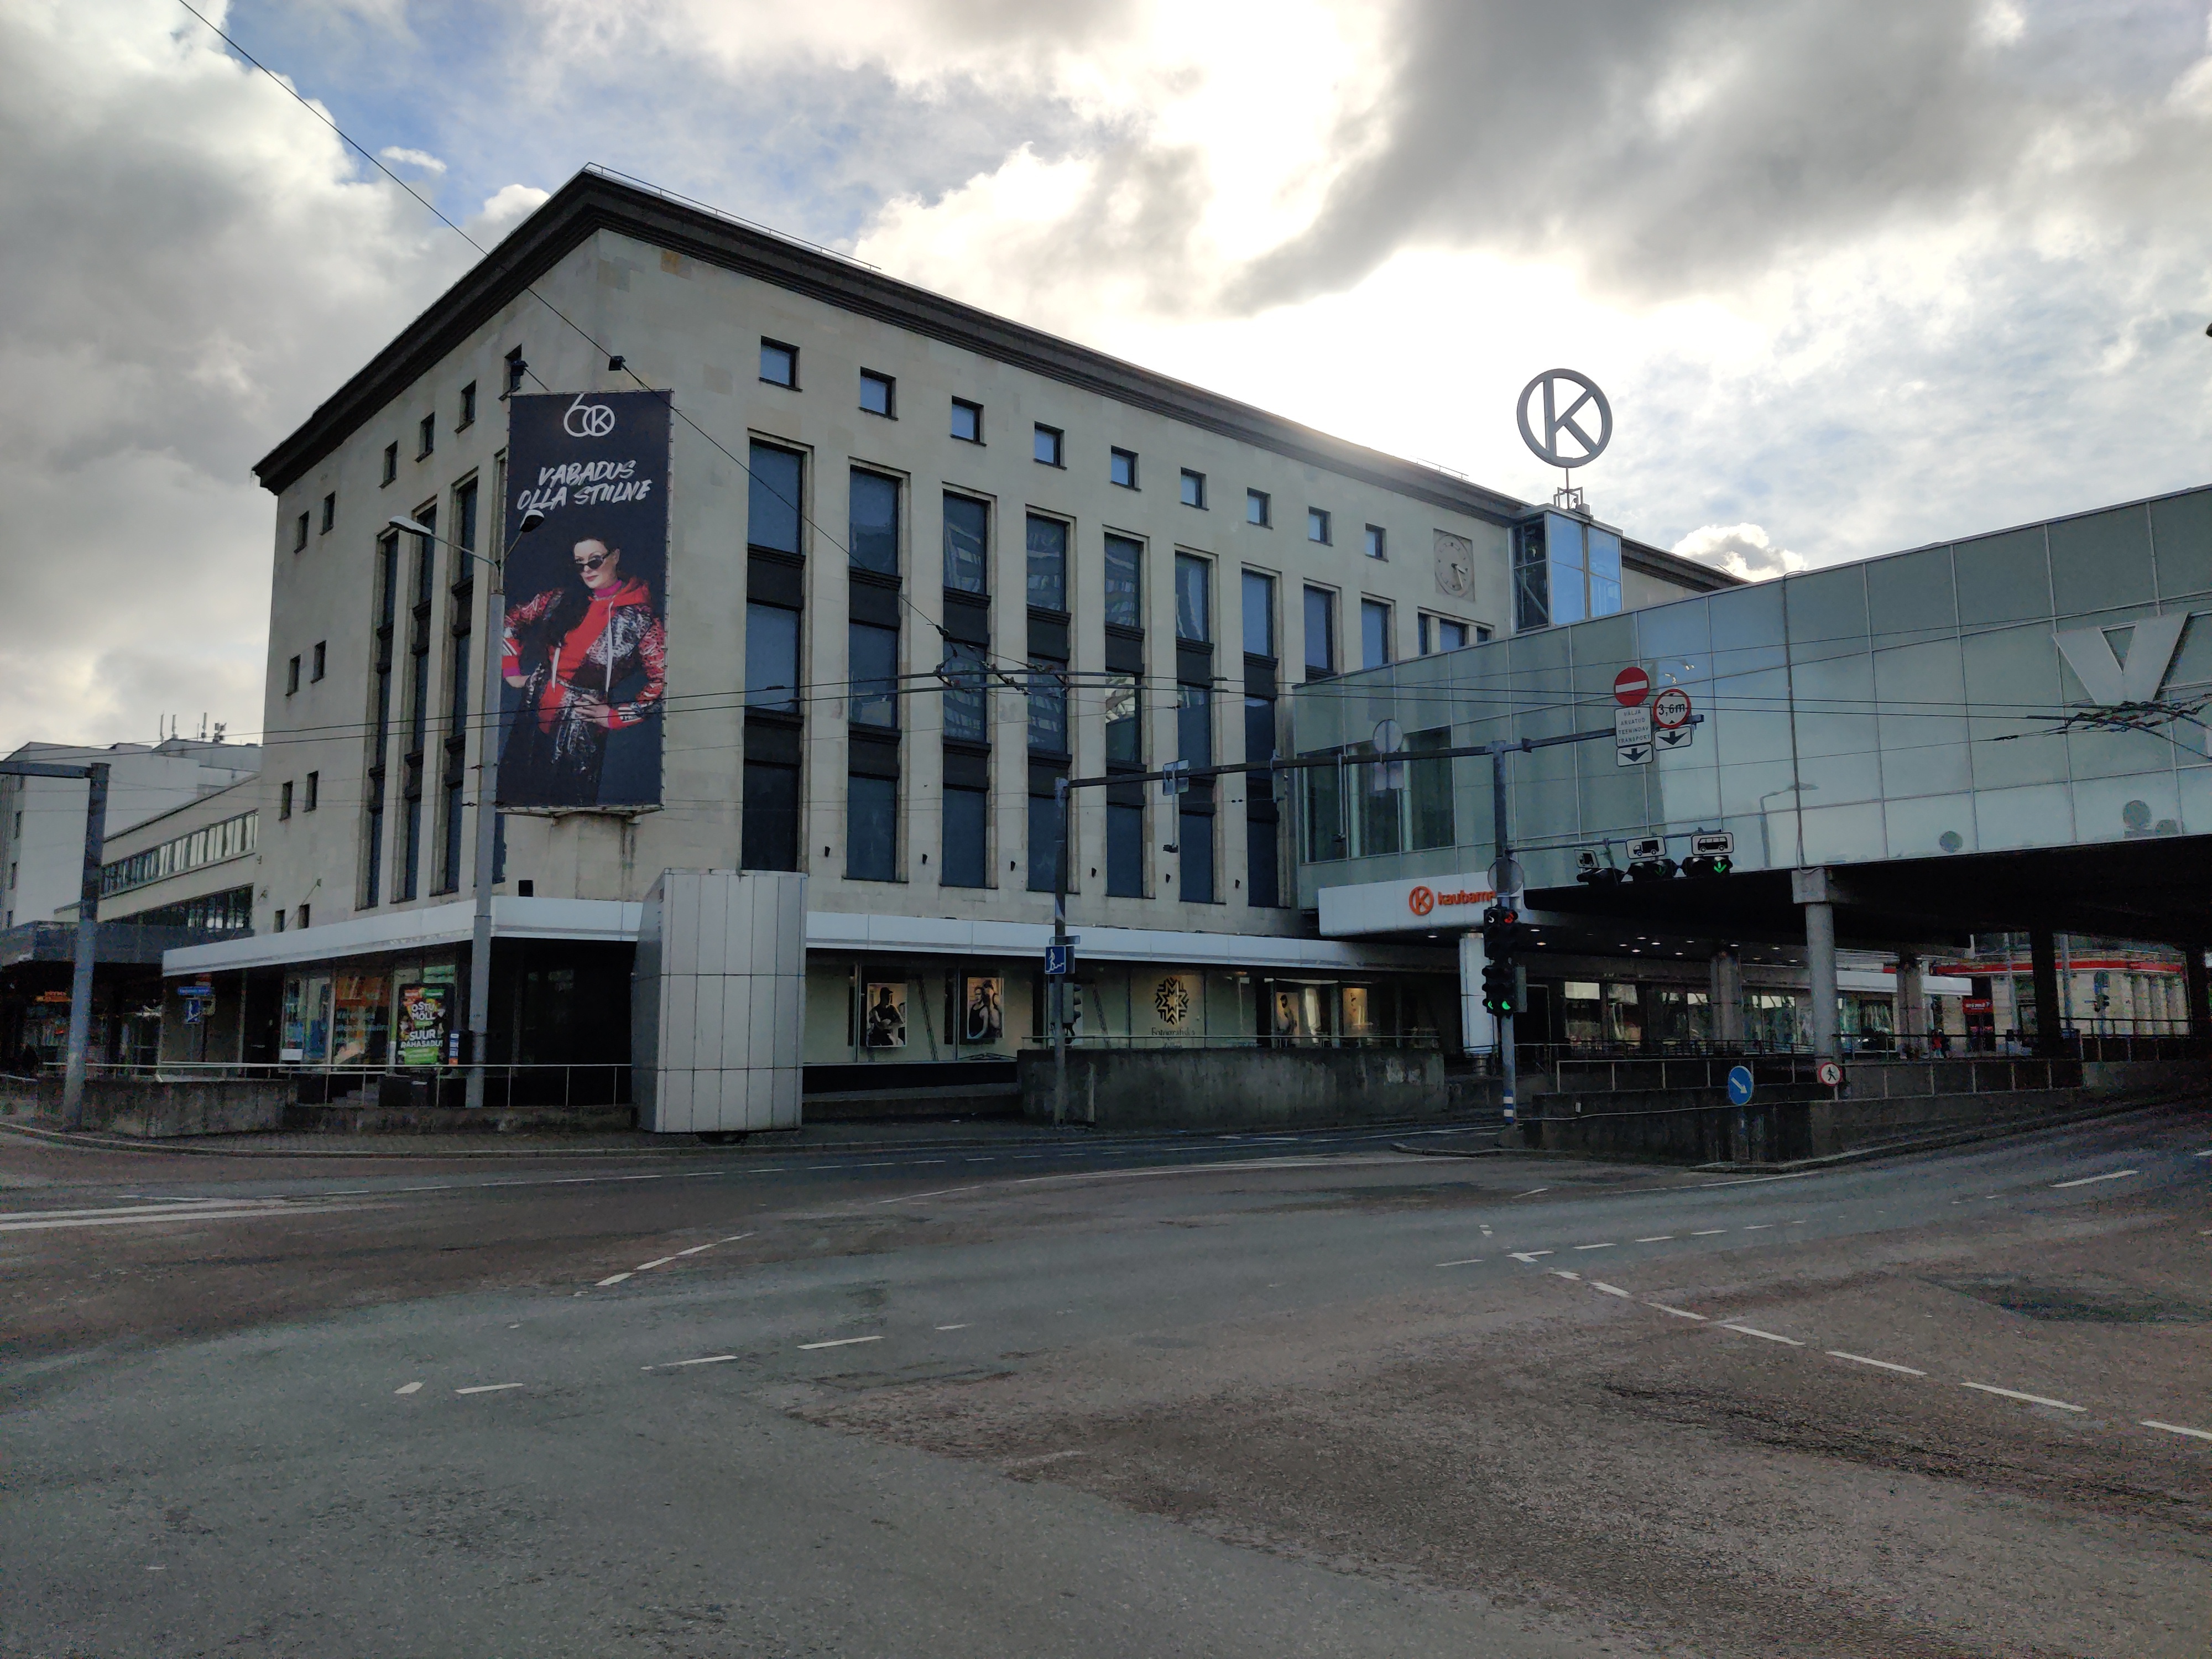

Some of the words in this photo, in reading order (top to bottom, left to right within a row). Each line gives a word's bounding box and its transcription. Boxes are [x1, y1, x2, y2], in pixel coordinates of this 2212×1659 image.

[1517, 368, 1613, 468] K
[538, 460, 637, 488] VABADUS
[517, 486, 568, 510] OLLA
[573, 479, 653, 505] STIILNE
[1618, 734, 1650, 744] TRANSPORT
[411, 1001, 435, 1011] OSTU
[409, 1029, 436, 1041] SUUR
